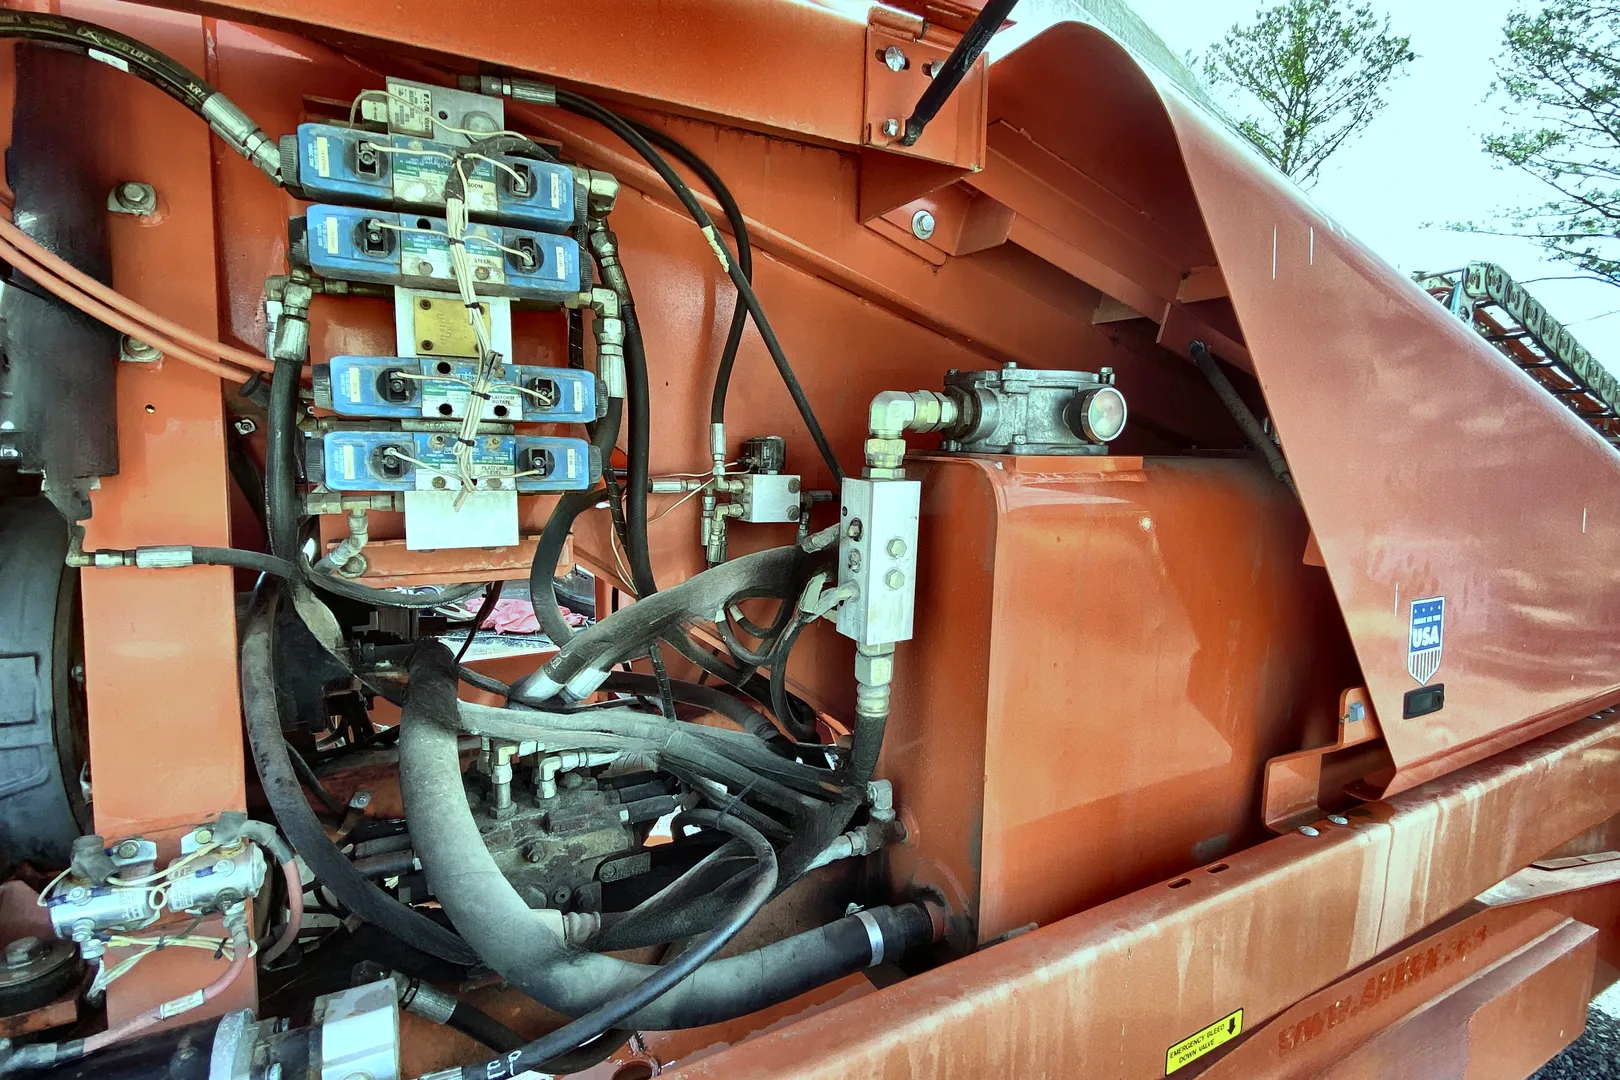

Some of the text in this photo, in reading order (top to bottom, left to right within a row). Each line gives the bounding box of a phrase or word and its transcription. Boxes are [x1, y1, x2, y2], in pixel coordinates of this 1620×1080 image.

[1412, 625, 1440, 648] USA
[1169, 1023, 1225, 1059] EMERGENCY BLEED
[1178, 1038, 1216, 1064] DOWN VALVE
